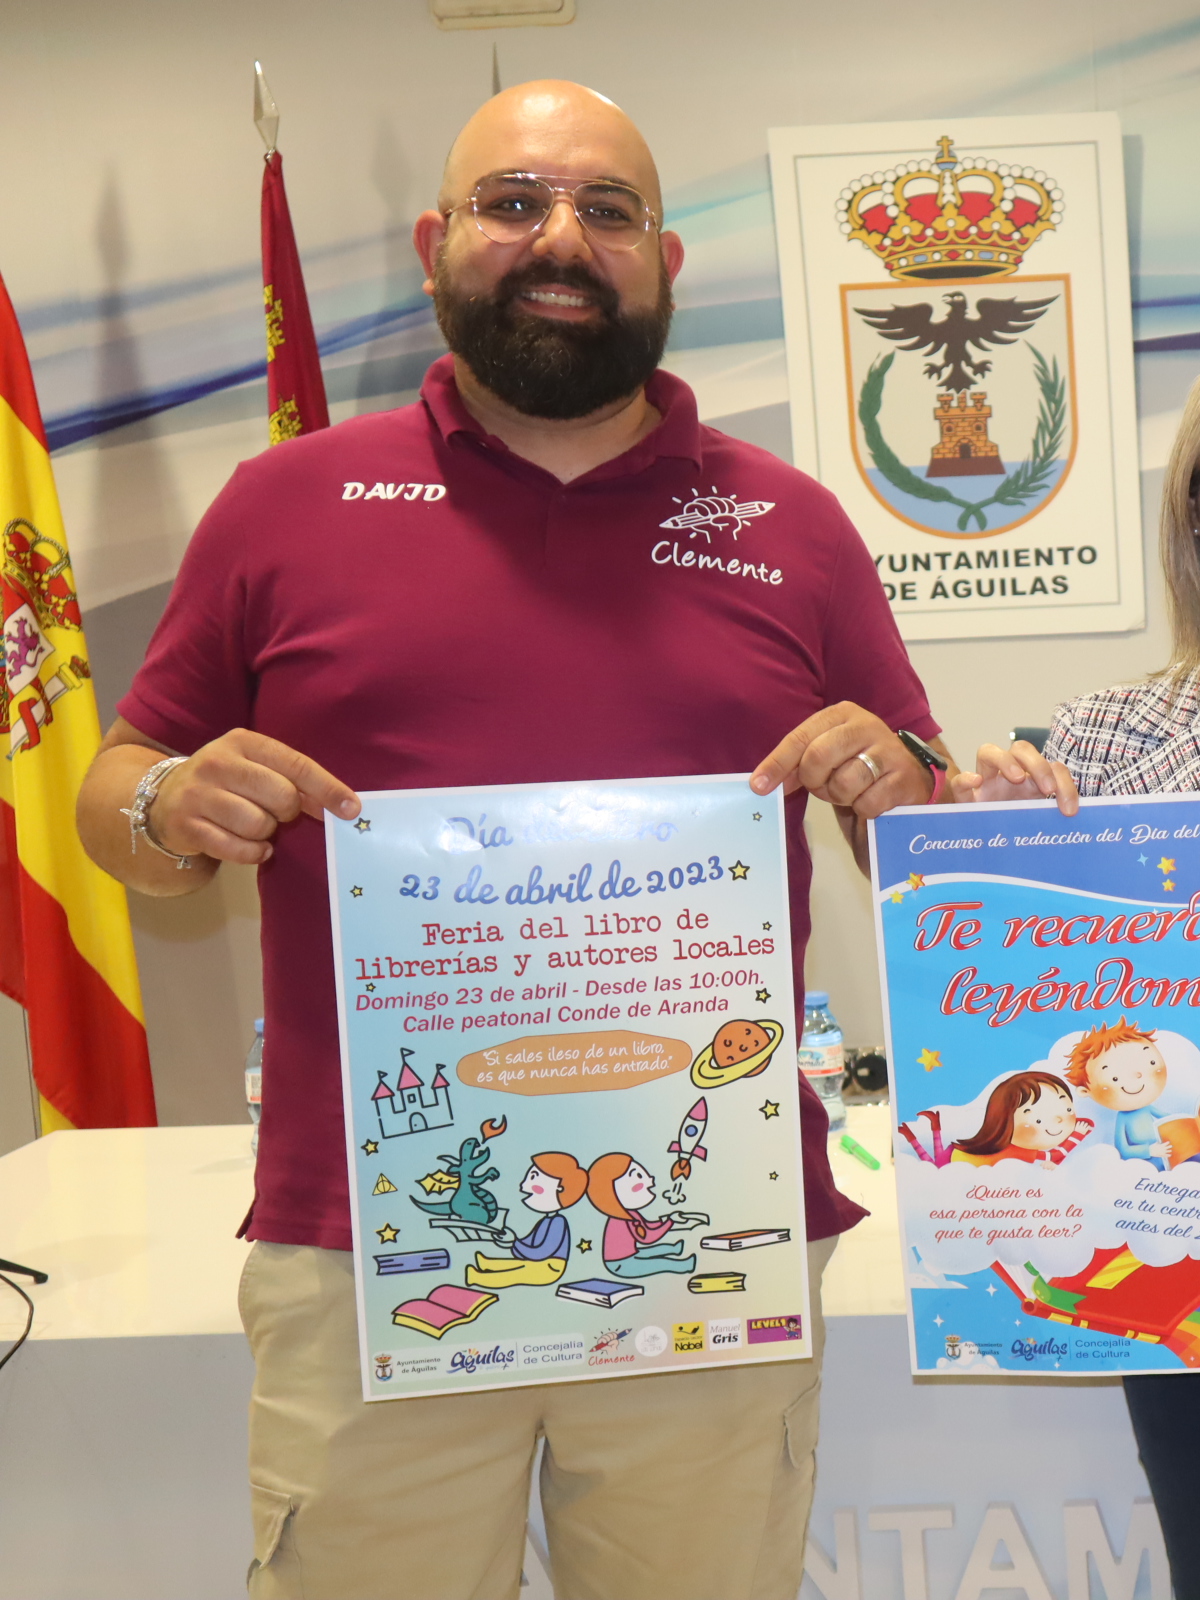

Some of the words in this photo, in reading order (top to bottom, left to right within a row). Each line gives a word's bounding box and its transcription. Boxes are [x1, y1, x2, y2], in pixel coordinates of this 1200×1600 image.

[650, 540, 784, 586] Clemente
[873, 545, 1098, 573] YUNTAMIENTO
[930, 574, 1069, 600] ÁGUILAS
[908, 834, 984, 855] Concurso
[987, 833, 1009, 847] de
[1013, 831, 1092, 847] redacción
[1095, 828, 1123, 842] del
[1173, 824, 1200, 839] del
[399, 873, 441, 901] 23
[453, 864, 500, 905] de
[504, 862, 593, 905] abril
[598, 859, 642, 901] de
[646, 855, 725, 894] 2023
[421, 921, 504, 946] Feria
[519, 916, 569, 940] del
[584, 912, 662, 937] libro
[676, 908, 710, 930] de
[912, 901, 984, 952] Te
[355, 951, 498, 980] librerías
[513, 953, 532, 977] y
[547, 943, 658, 969] autores
[672, 935, 775, 961] locales
[355, 991, 449, 1011] Domingo
[455, 987, 484, 1005] 23
[489, 986, 515, 1003] de
[521, 982, 567, 1000] abril
[585, 978, 647, 997] Desde
[654, 976, 682, 992] las
[689, 970, 765, 989] 10:00h.
[403, 1014, 455, 1033] Calle
[461, 1008, 551, 1033] peatonal
[557, 1004, 621, 1022] Conde
[627, 1001, 652, 1019] de
[657, 996, 729, 1016] Aranda
[505, 1048, 543, 1065] sales
[548, 1045, 580, 1062] ileso
[584, 1043, 604, 1059] de
[608, 1046, 628, 1057] un
[632, 1040, 665, 1056] libro,
[476, 1071, 493, 1084] es
[497, 1067, 526, 1086] que
[530, 1063, 578, 1079] nunca
[581, 1060, 609, 1077] has
[965, 1184, 1022, 1201] ¿Quién
[1025, 1188, 1044, 1198] es
[1134, 1177, 1200, 1204] Entrega
[929, 1208, 957, 1220] esa
[958, 1208, 1028, 1223] persona
[1031, 1208, 1061, 1219] con
[1065, 1203, 1084, 1218] la
[1113, 1198, 1134, 1210] en
[1137, 1199, 1156, 1213] tu
[934, 1228, 965, 1244] que
[968, 1226, 984, 1239] te
[986, 1225, 1034, 1246] gusta
[1037, 1223, 1083, 1239] leer?
[1114, 1218, 1160, 1234] antes
[1163, 1223, 1194, 1239] del
[709, 1323, 741, 1334] Manuel
[712, 1333, 739, 1345] Gris
[523, 1355, 538, 1365] de
[541, 1352, 583, 1363] Cultura
[674, 1340, 703, 1352] Nobel
[588, 1354, 636, 1366] Clemente
